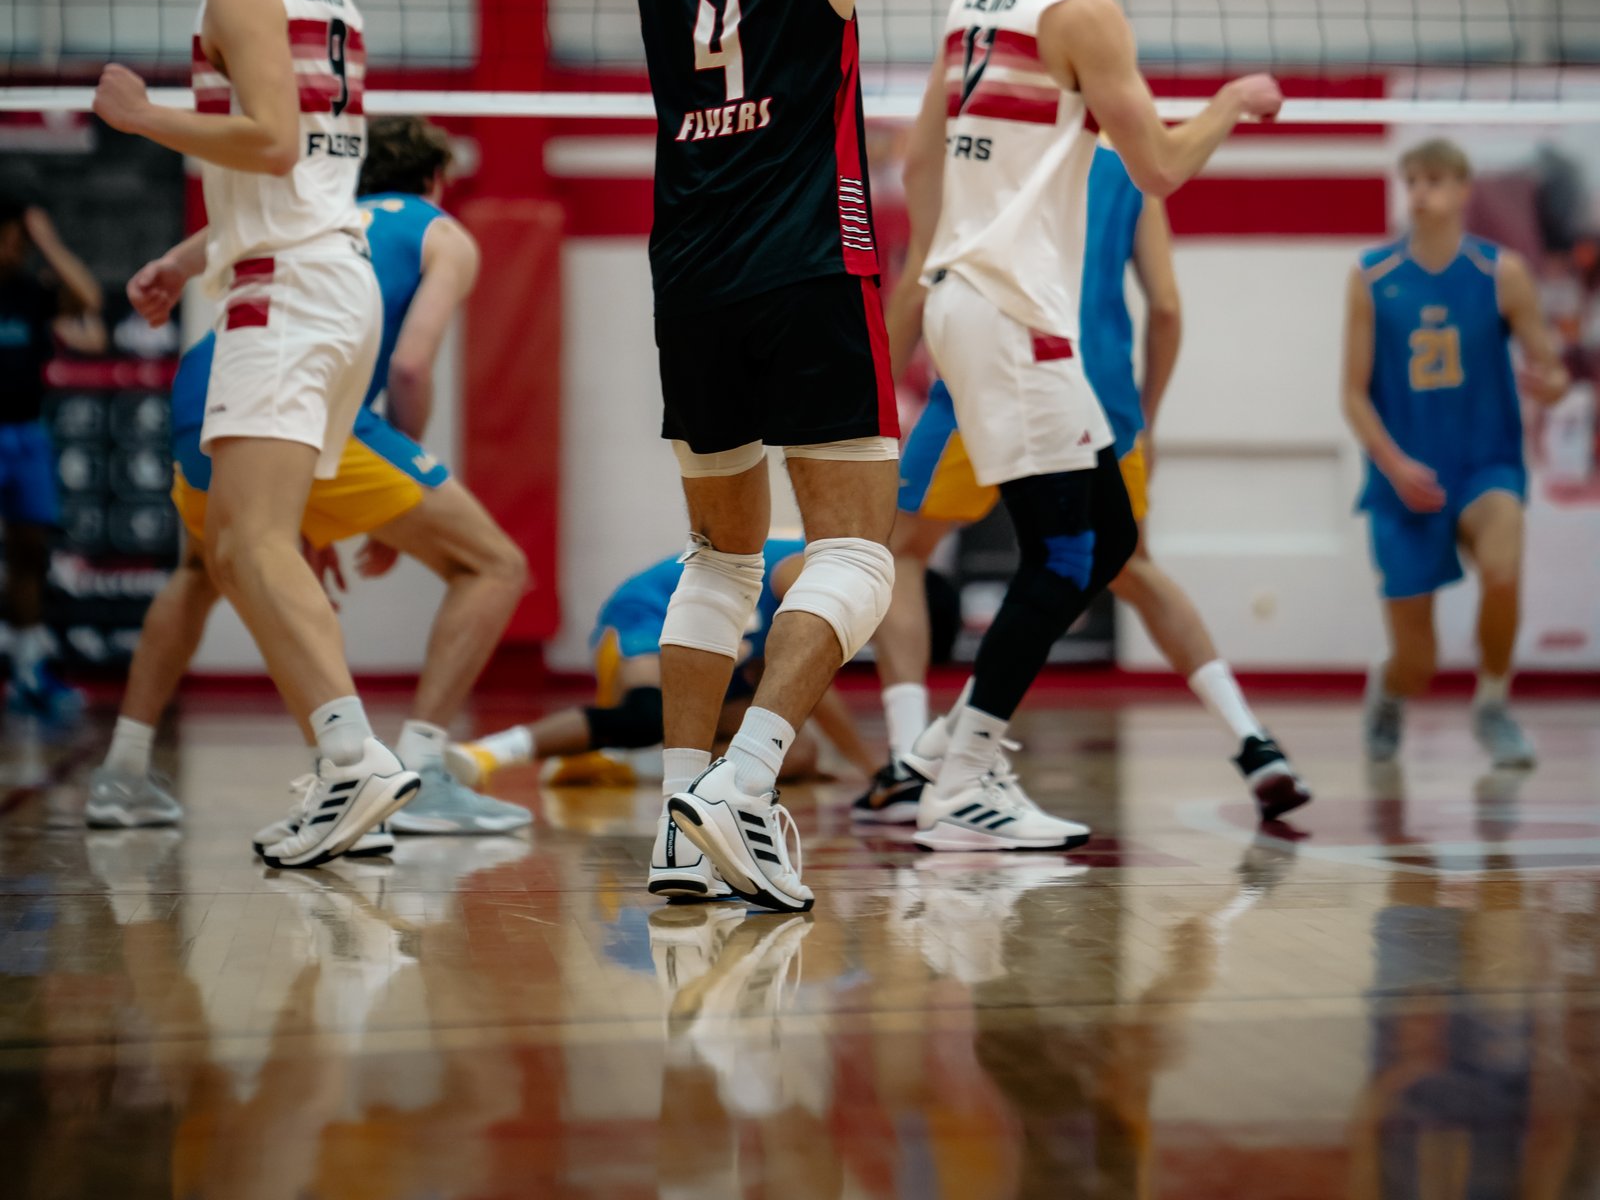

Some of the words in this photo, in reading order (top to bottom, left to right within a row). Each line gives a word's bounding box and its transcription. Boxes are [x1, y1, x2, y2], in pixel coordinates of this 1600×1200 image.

[329, 18, 348, 117] 9
[675, 97, 773, 142] FLYERS
[1409, 326, 1464, 390] 21
